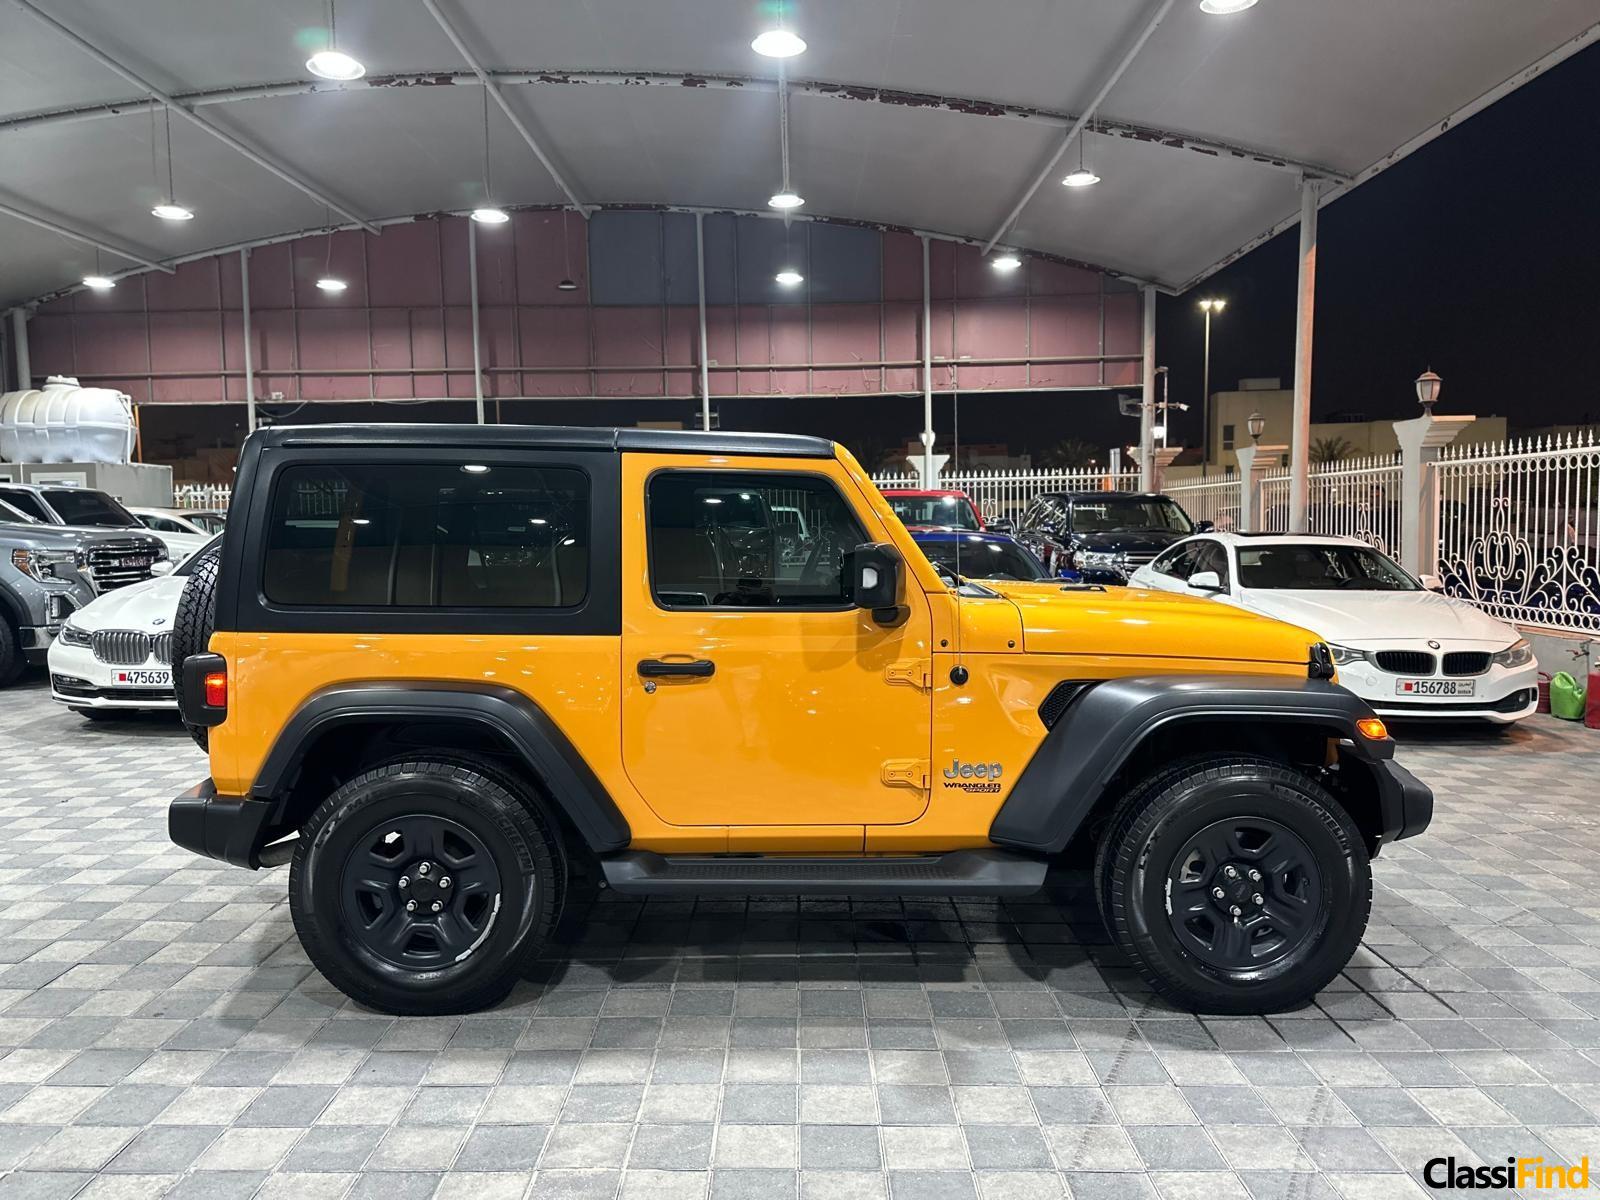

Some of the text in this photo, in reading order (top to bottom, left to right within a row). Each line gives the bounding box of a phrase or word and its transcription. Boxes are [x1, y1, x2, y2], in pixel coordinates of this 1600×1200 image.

[127, 671, 170, 684] 475639
[1413, 681, 1456, 694] 156788
[943, 758, 1002, 781] Jeep
[1294, 792, 1350, 854] MICHELIN
